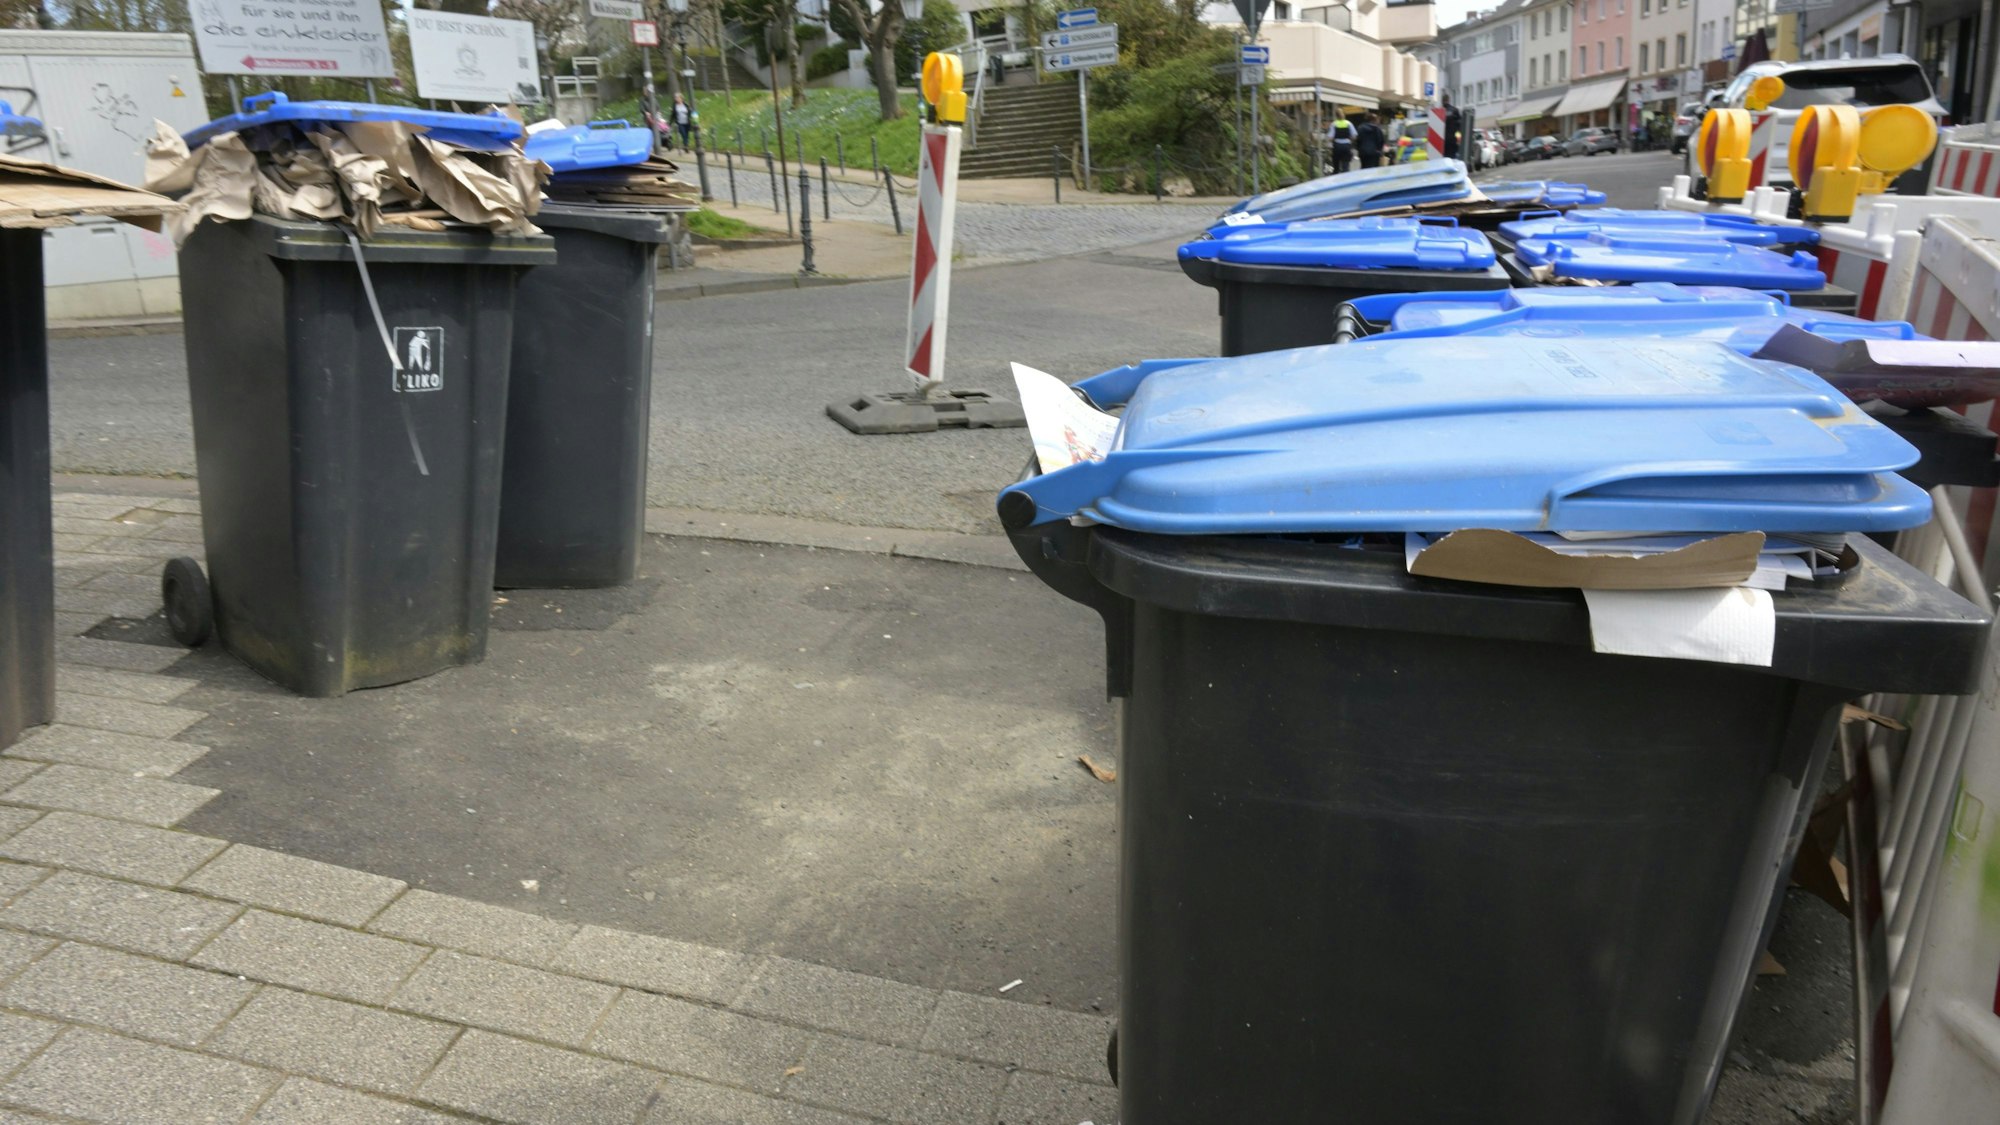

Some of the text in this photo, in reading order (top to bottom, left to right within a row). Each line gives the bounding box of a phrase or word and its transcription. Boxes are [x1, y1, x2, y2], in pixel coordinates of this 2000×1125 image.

[241, 5, 361, 23] für sie und ihn
[203, 22, 247, 37] die
[414, 17, 433, 31] DU
[436, 19, 463, 34] BIST
[399, 373, 440, 389] LIKO
